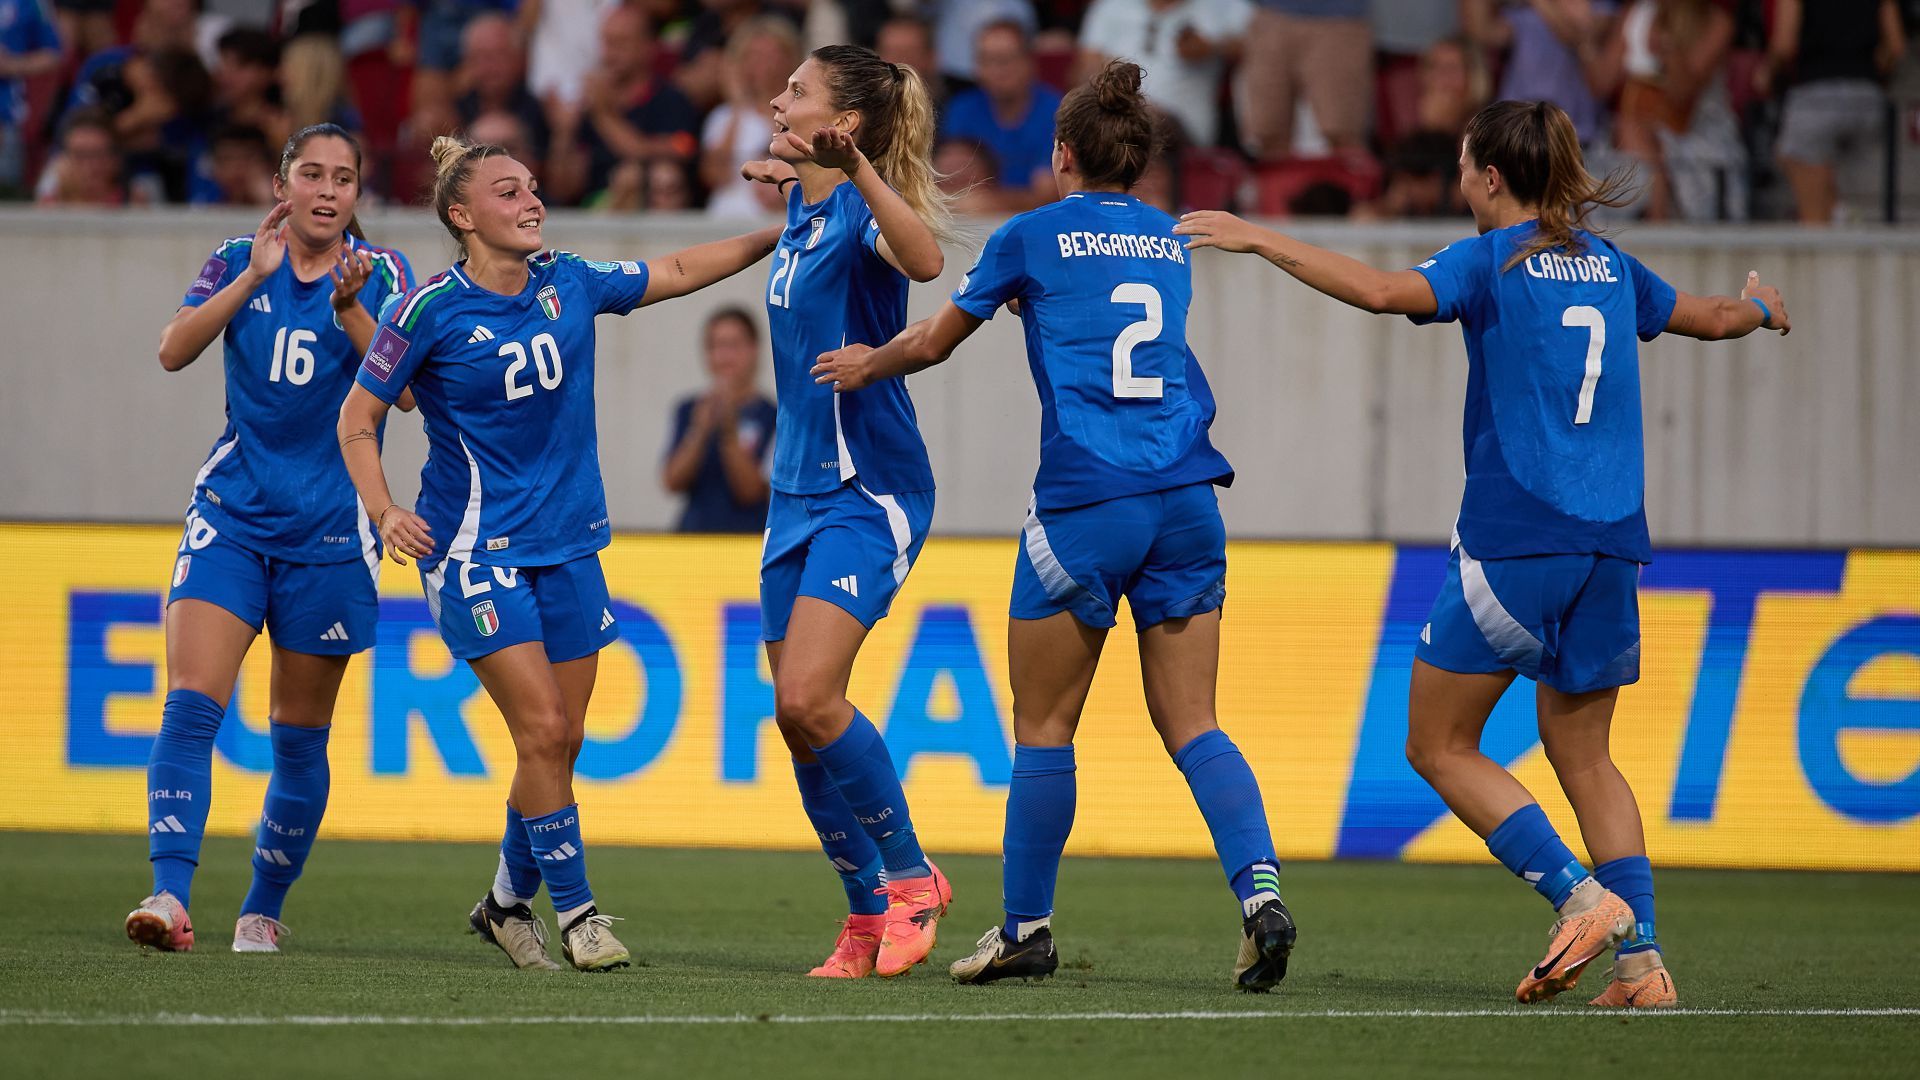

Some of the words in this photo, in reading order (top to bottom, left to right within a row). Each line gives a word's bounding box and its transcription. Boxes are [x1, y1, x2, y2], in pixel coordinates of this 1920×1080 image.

[1057, 231, 1185, 264] BERGAMASCHI
[1525, 252, 1618, 283] CANTORE
[537, 287, 555, 300] ITALIA
[770, 247, 799, 308] 21
[269, 326, 318, 386] 16
[1110, 282, 1163, 398] 2
[498, 332, 563, 401] 20
[1562, 305, 1606, 424] 7
[473, 603, 493, 616] ITALIA
[533, 816, 575, 833] ITALIA
